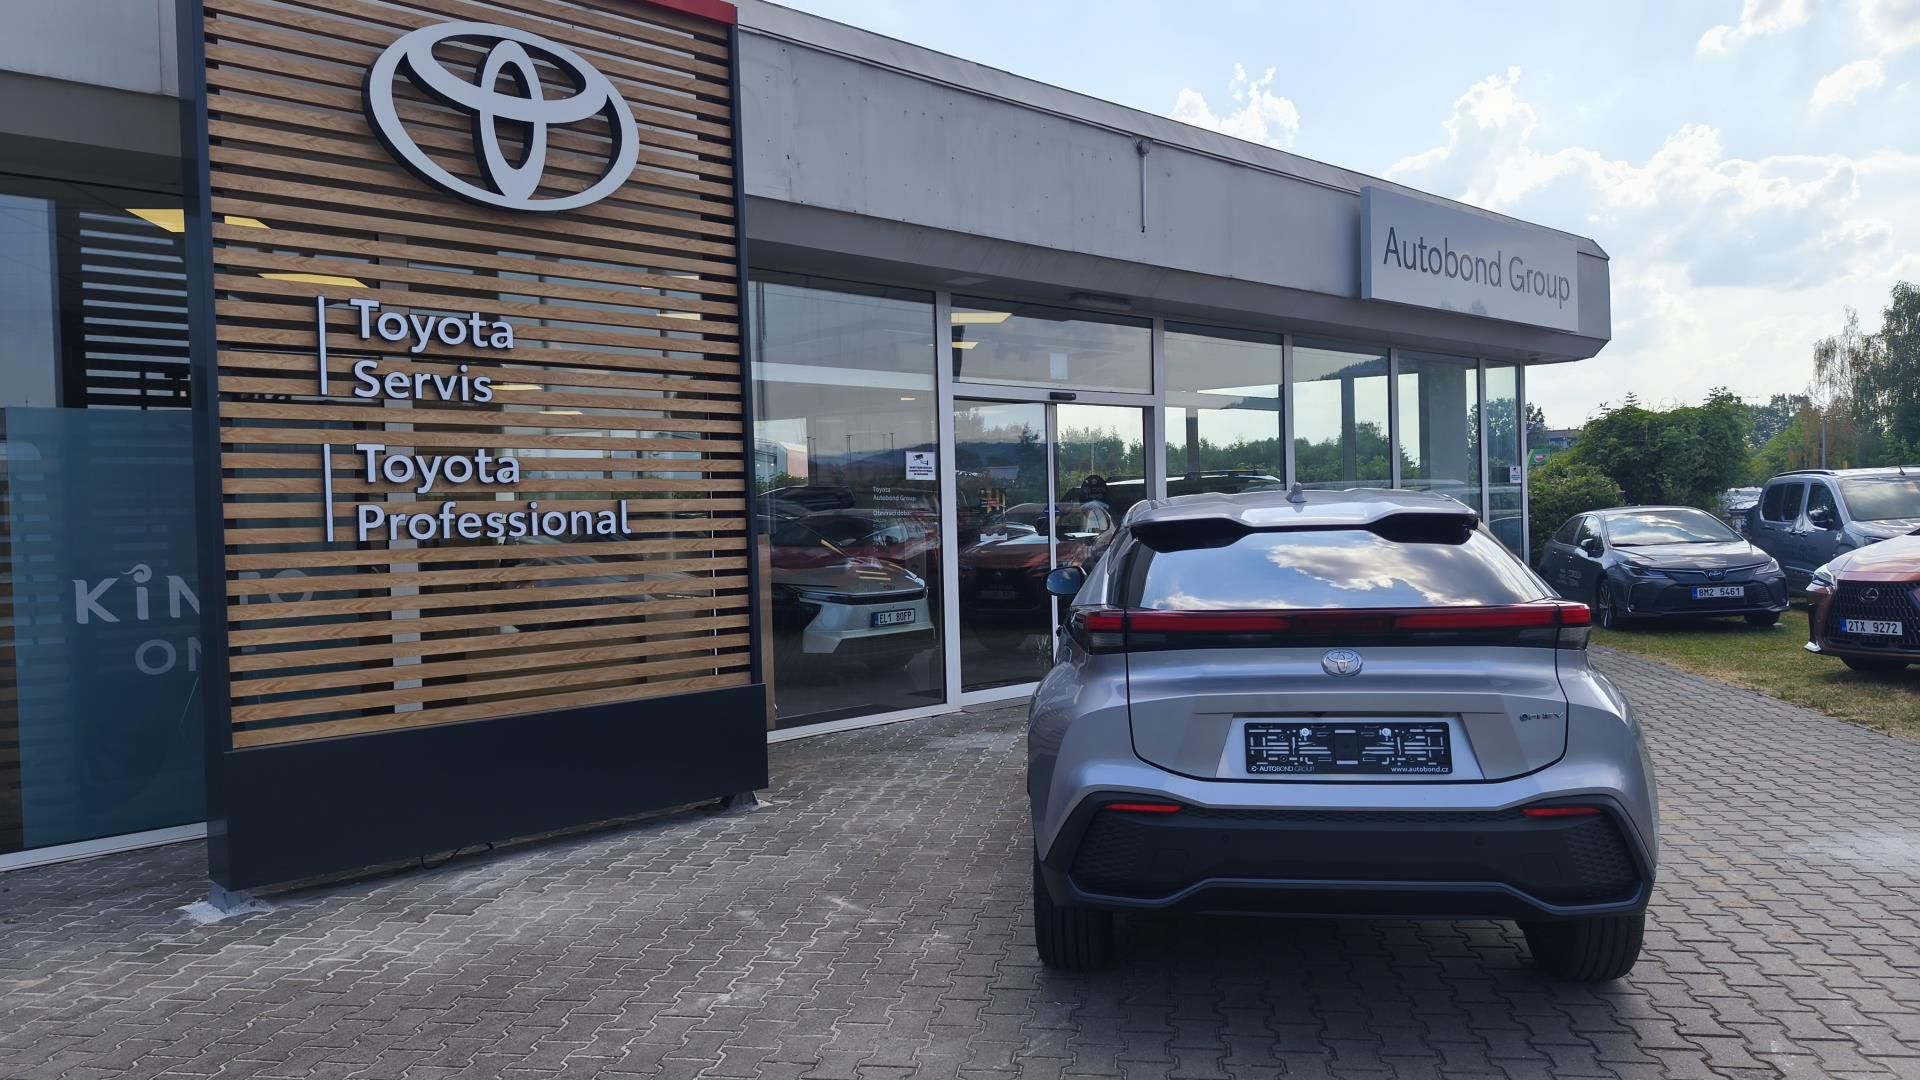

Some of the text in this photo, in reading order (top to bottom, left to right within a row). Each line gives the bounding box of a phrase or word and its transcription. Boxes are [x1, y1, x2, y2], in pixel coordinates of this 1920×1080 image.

[1383, 226, 1570, 309] Autobond Group
[349, 297, 515, 353] Toyota
[353, 359, 494, 403] Servis
[355, 443, 521, 494] Toyota
[873, 486, 891, 494] Toyota
[357, 498, 631, 542] Professional
[1719, 587, 1740, 596] 5461
[880, 613, 892, 623] EL1
[1848, 620, 1898, 634] 2TX 9272
[1390, 765, 1449, 773] www.autobond.cz
